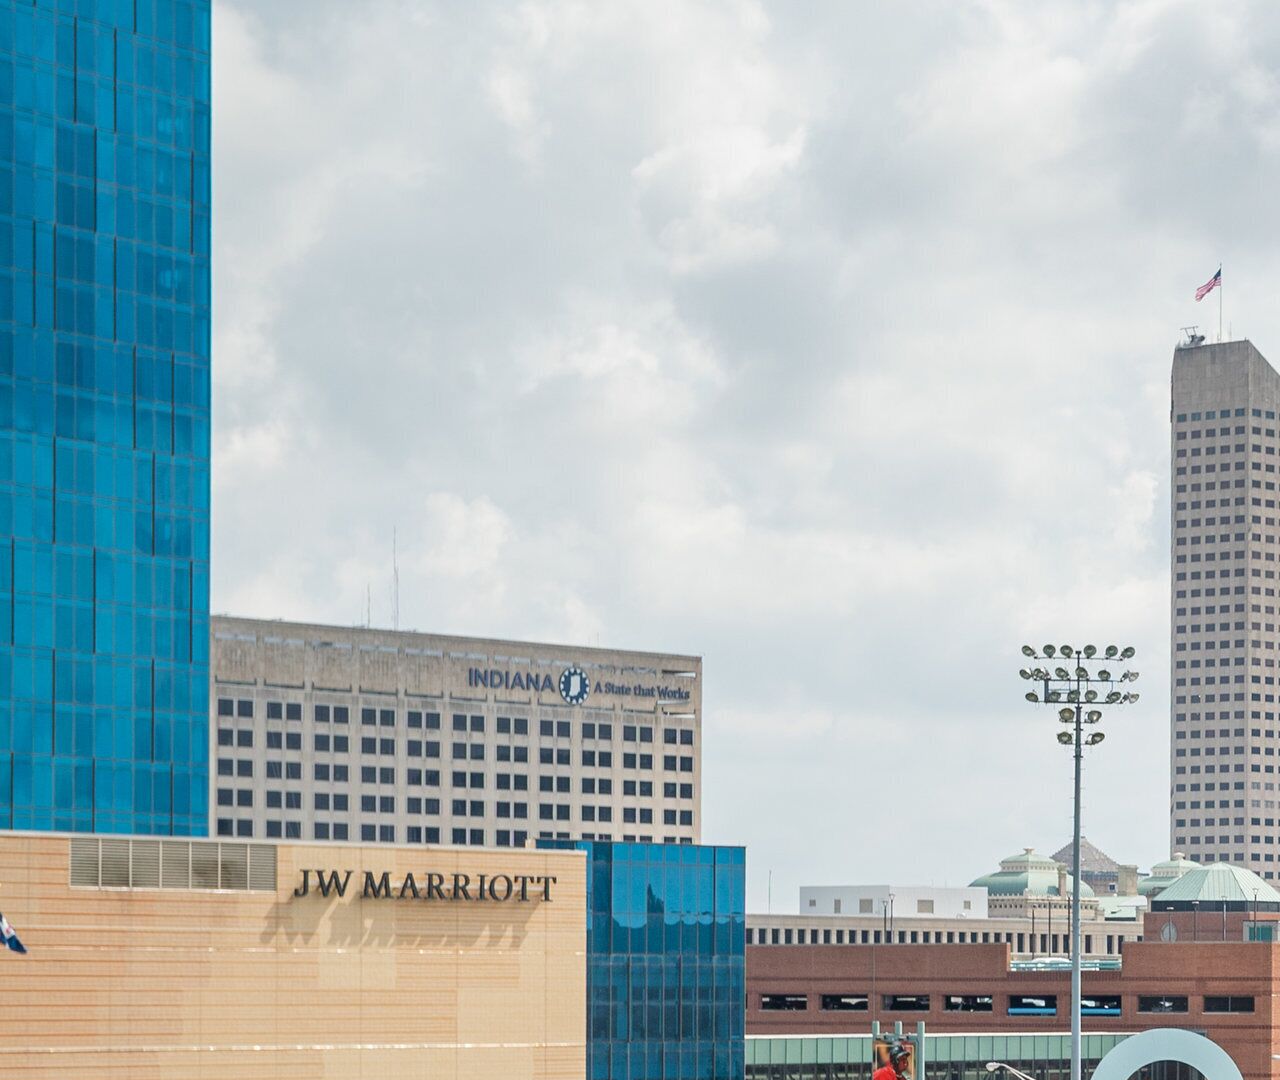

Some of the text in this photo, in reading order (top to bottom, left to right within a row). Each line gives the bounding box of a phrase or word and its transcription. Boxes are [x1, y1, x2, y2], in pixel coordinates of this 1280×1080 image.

[468, 667, 556, 693] INDIANA
[594, 684, 690, 700] A State that Works
[294, 869, 557, 902] JW MARRIOTT
